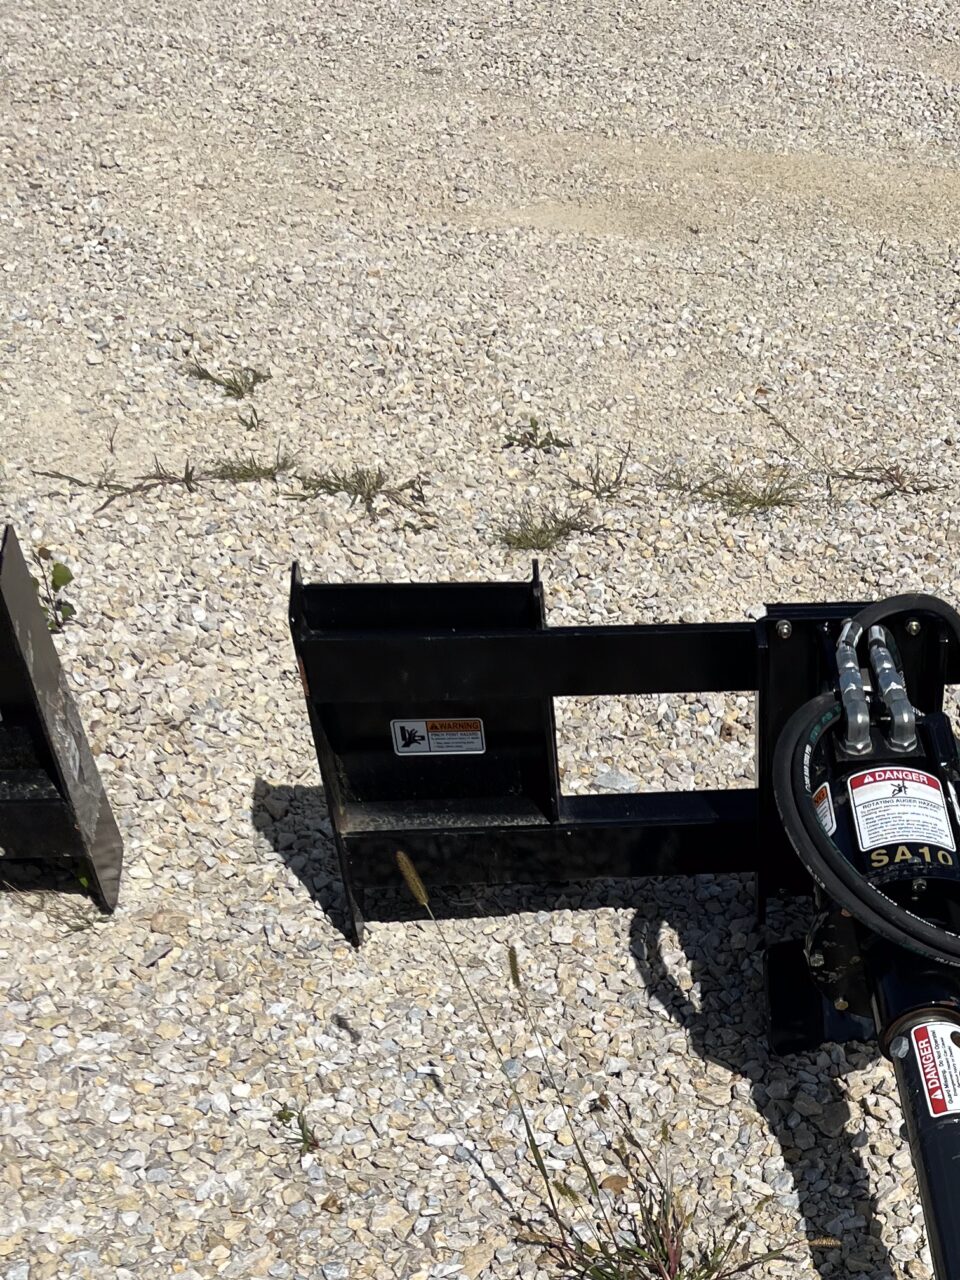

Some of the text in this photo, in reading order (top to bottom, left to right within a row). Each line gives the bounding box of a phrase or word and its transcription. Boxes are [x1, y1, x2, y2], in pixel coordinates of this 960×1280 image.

[438, 722, 479, 730] WARNING
[875, 771, 928, 784] DANGER
[862, 799, 894, 810] ROTATING
[870, 845, 953, 868] SA10
[918, 1038, 940, 1089] DANGER
[945, 1089, 953, 1104] Guard
